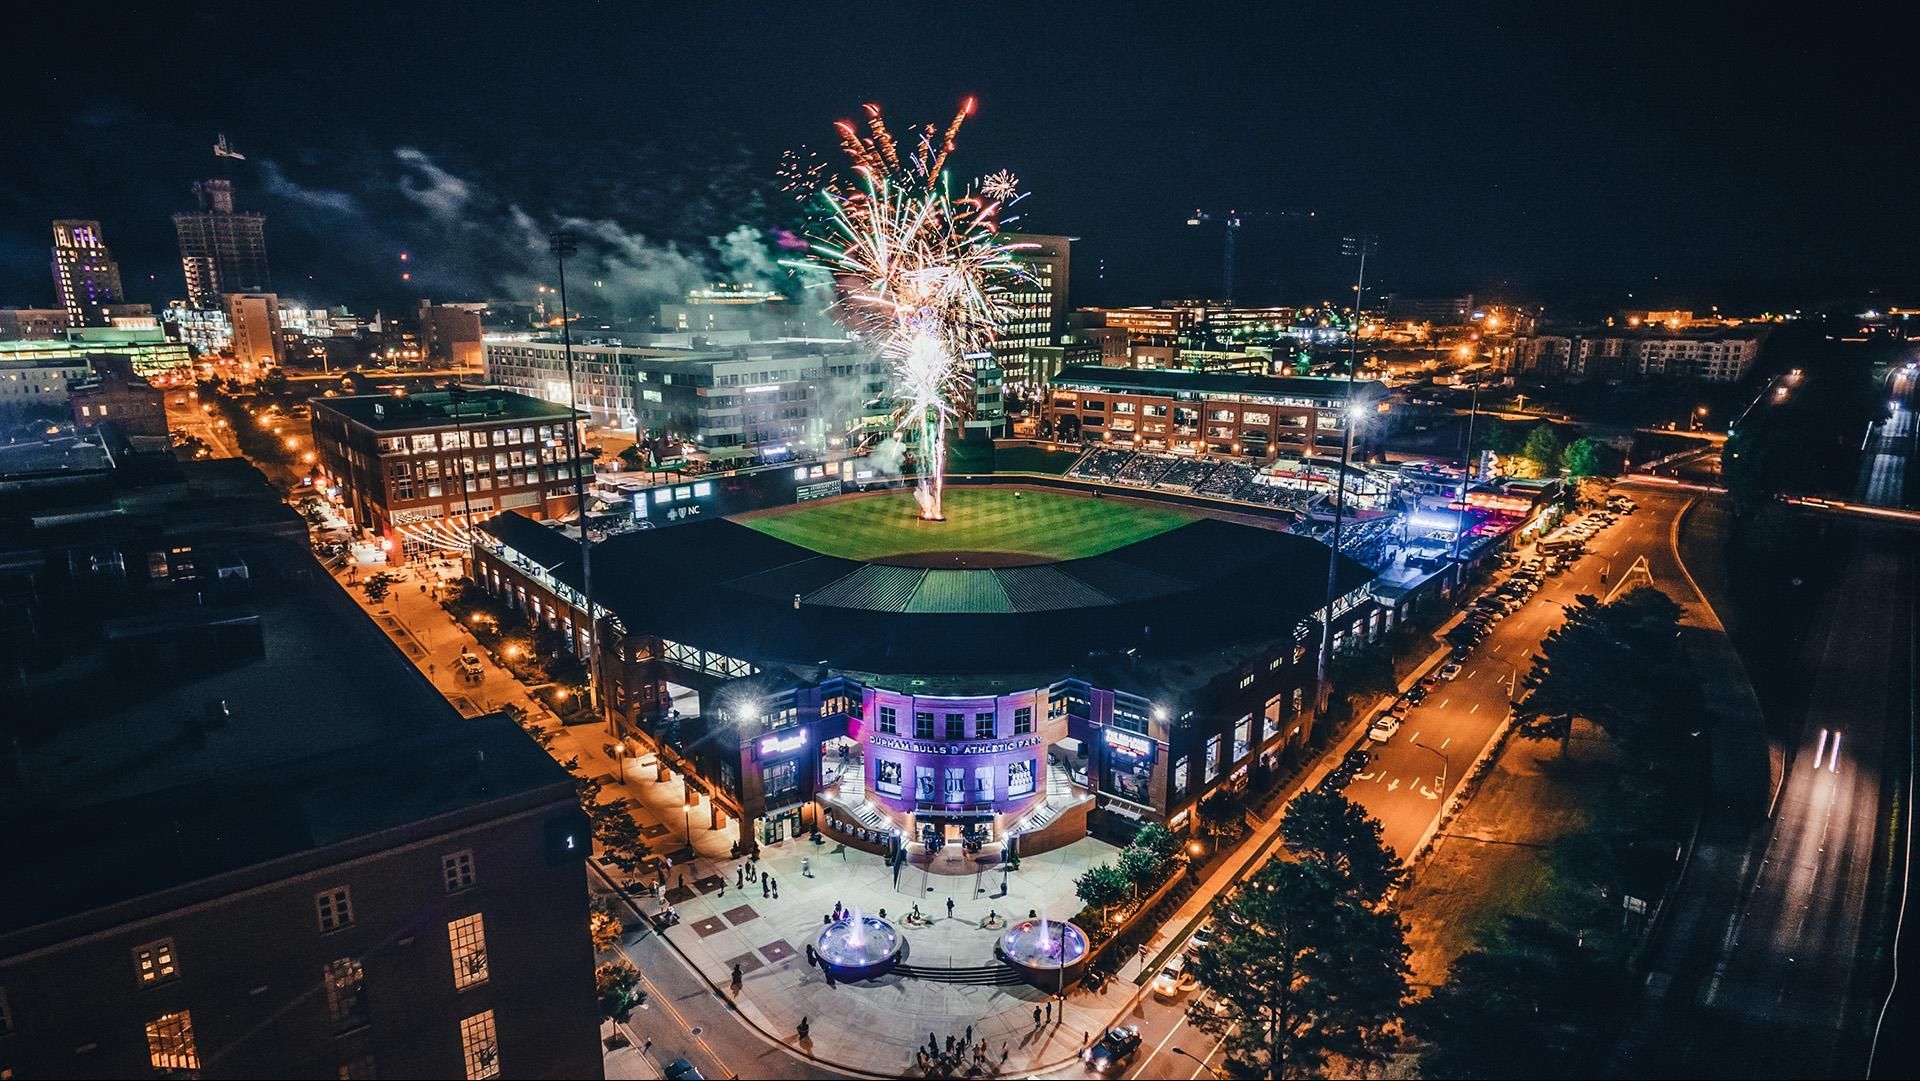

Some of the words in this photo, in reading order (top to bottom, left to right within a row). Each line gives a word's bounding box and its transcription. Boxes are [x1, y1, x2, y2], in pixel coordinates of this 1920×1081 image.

[688, 505, 700, 515] NC
[869, 735, 910, 751] DURHAM
[913, 744, 947, 754] BULLS
[963, 742, 1014, 754] ATHLETIC
[1016, 736, 1043, 749] PARK
[566, 835, 575, 849] 1
